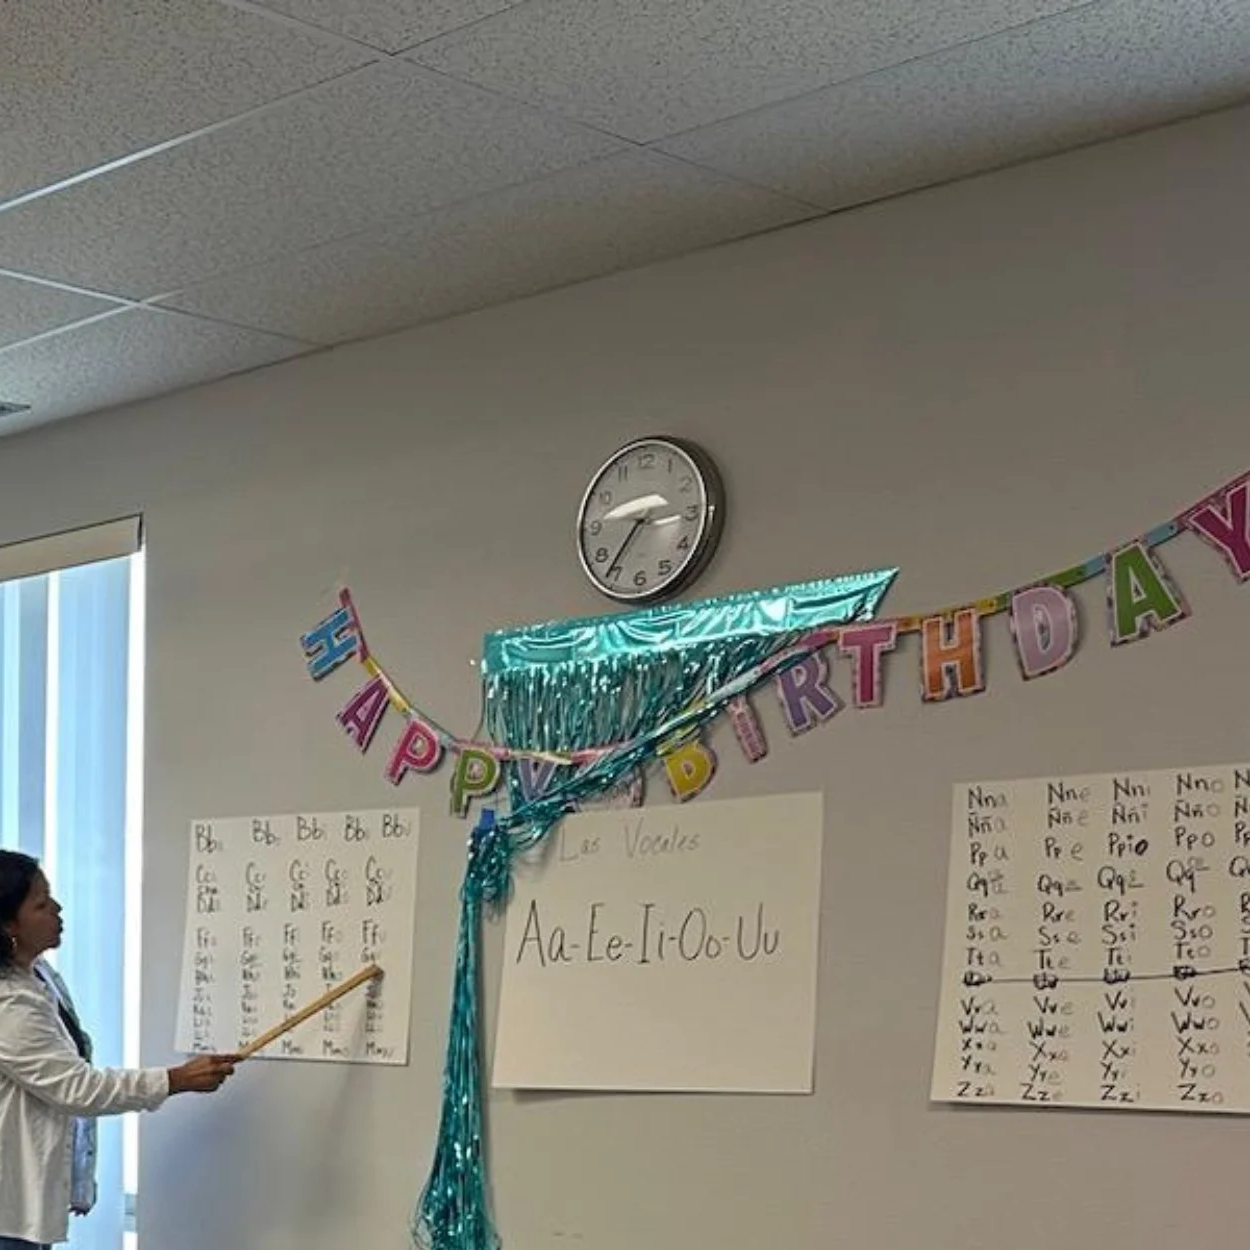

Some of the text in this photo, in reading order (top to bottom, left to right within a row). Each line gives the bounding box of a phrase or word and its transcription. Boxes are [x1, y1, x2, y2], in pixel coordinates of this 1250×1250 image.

[638, 454, 655, 469] 12
[685, 505, 699, 521] 3
[590, 520, 602, 536] 9
[677, 535, 689, 550] 4
[595, 548, 608, 563] 8
[658, 560, 672, 576] 5
[633, 570, 647, 586] 6
